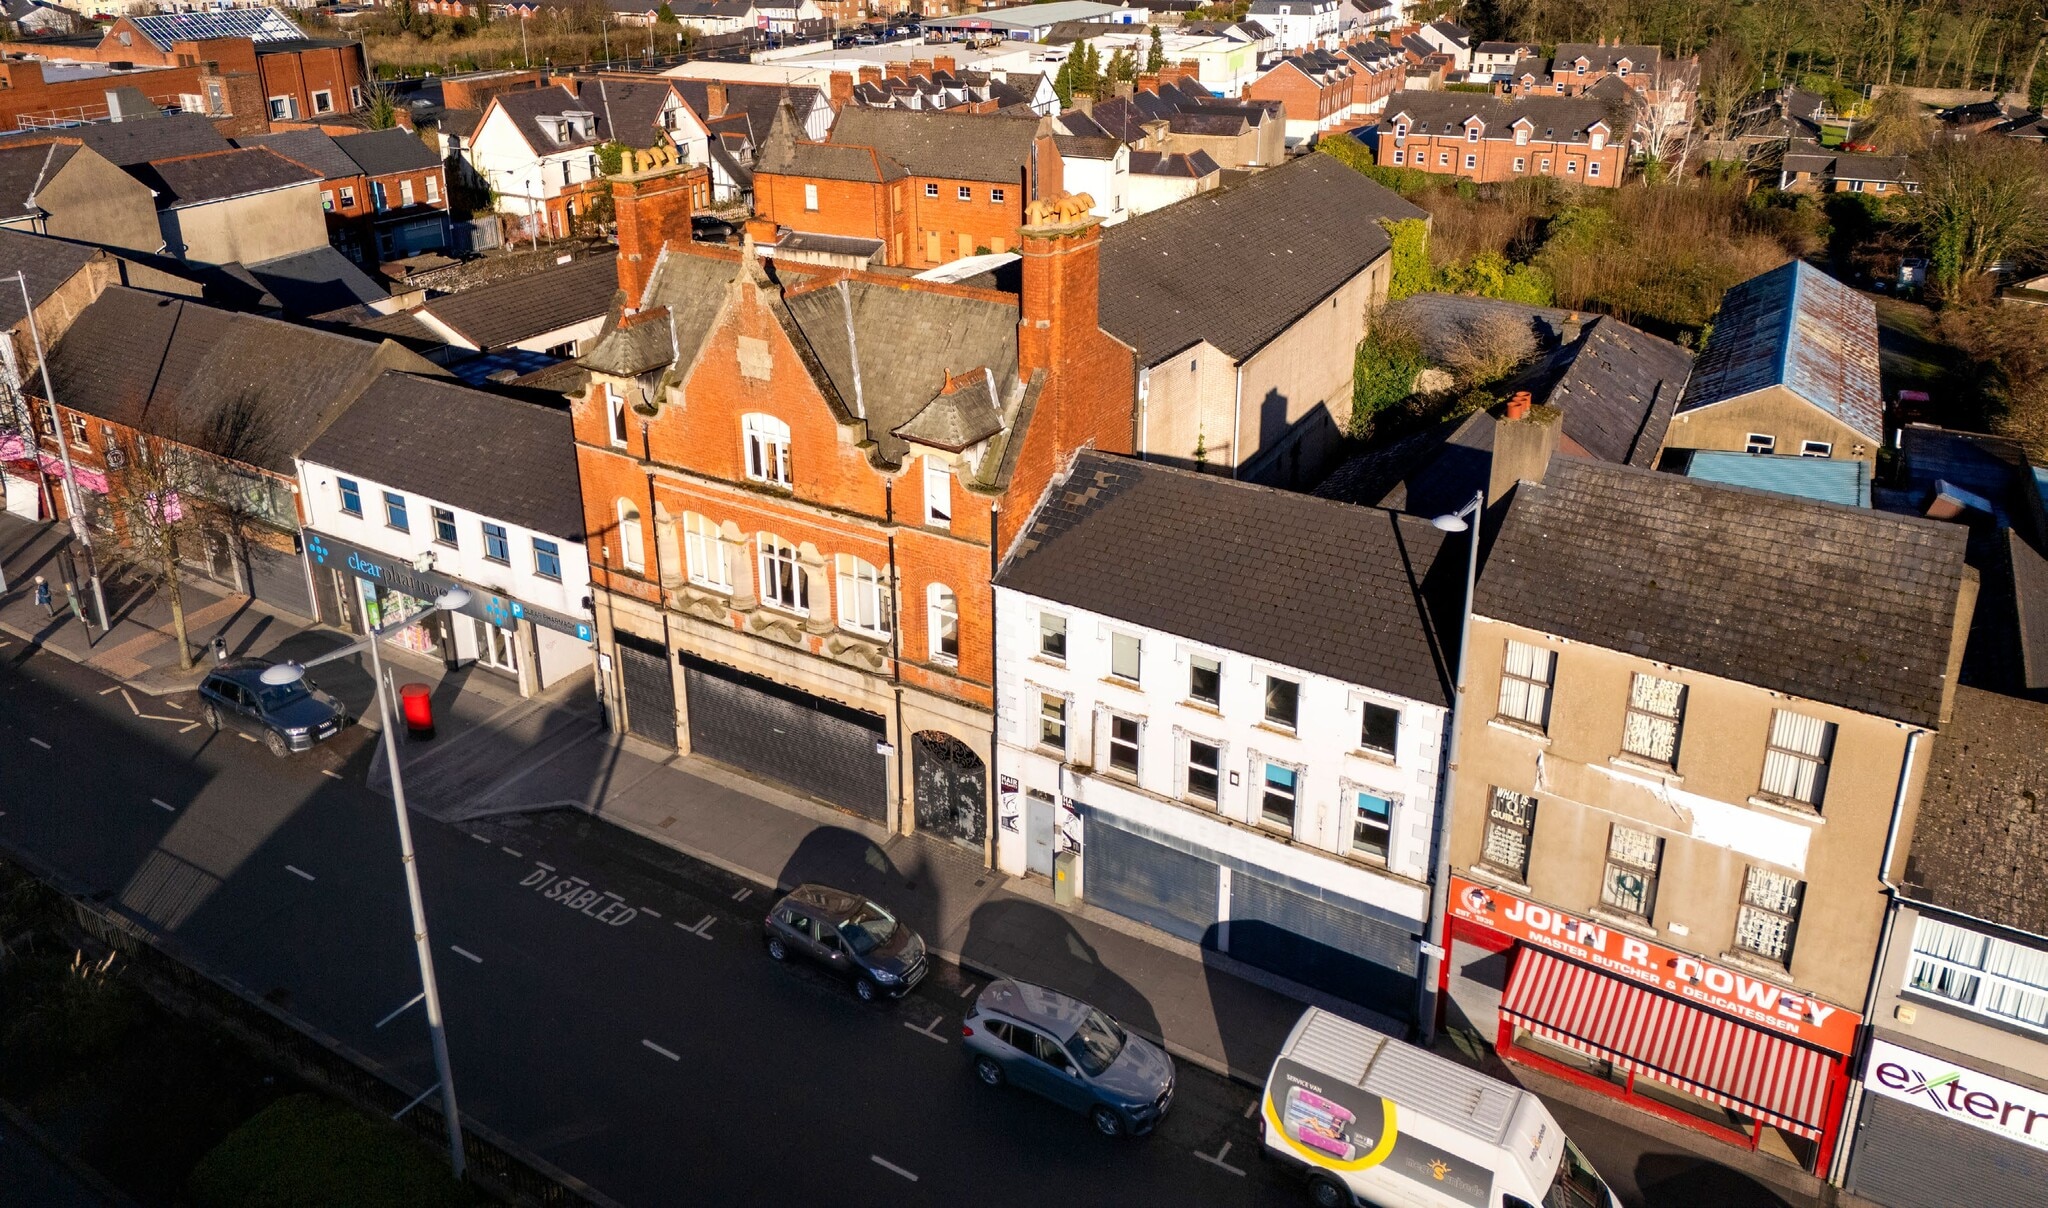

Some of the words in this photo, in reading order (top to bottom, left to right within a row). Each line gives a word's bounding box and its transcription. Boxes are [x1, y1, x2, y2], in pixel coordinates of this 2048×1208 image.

[348, 552, 382, 578] clear
[512, 604, 520, 616] P
[579, 626, 588, 638] P
[1496, 787, 1520, 802] WHAT
[1491, 809, 1524, 826] GUILD
[520, 869, 638, 926] DISABLED
[1505, 899, 1608, 952] JOHN
[1623, 940, 1658, 970] R.
[1674, 957, 1836, 1029] DOWEY
[1528, 930, 1588, 960] MASTER
[1592, 953, 1660, 984] BUTCHER
[1665, 980, 1677, 992] &
[1682, 984, 1800, 1034] DELICATESSEN
[1286, 1074, 1308, 1088] SERVICE
[1309, 1084, 1322, 1094] VAN
